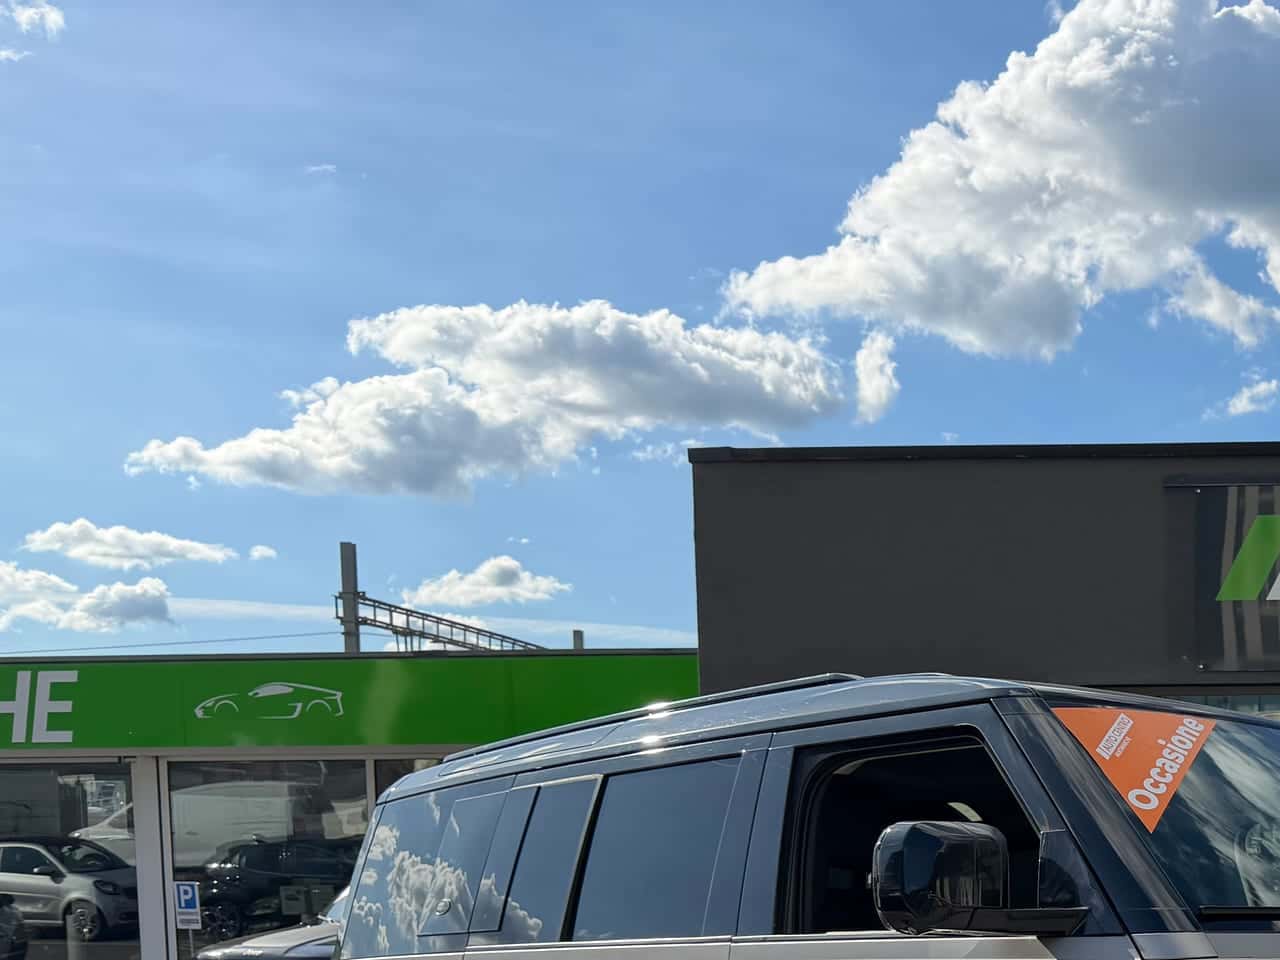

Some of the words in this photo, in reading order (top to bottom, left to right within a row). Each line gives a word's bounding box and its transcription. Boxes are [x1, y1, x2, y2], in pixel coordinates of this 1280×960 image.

[0, 670, 79, 743] HE
[1127, 718, 1205, 810] Occasione
[178, 884, 193, 908] P
